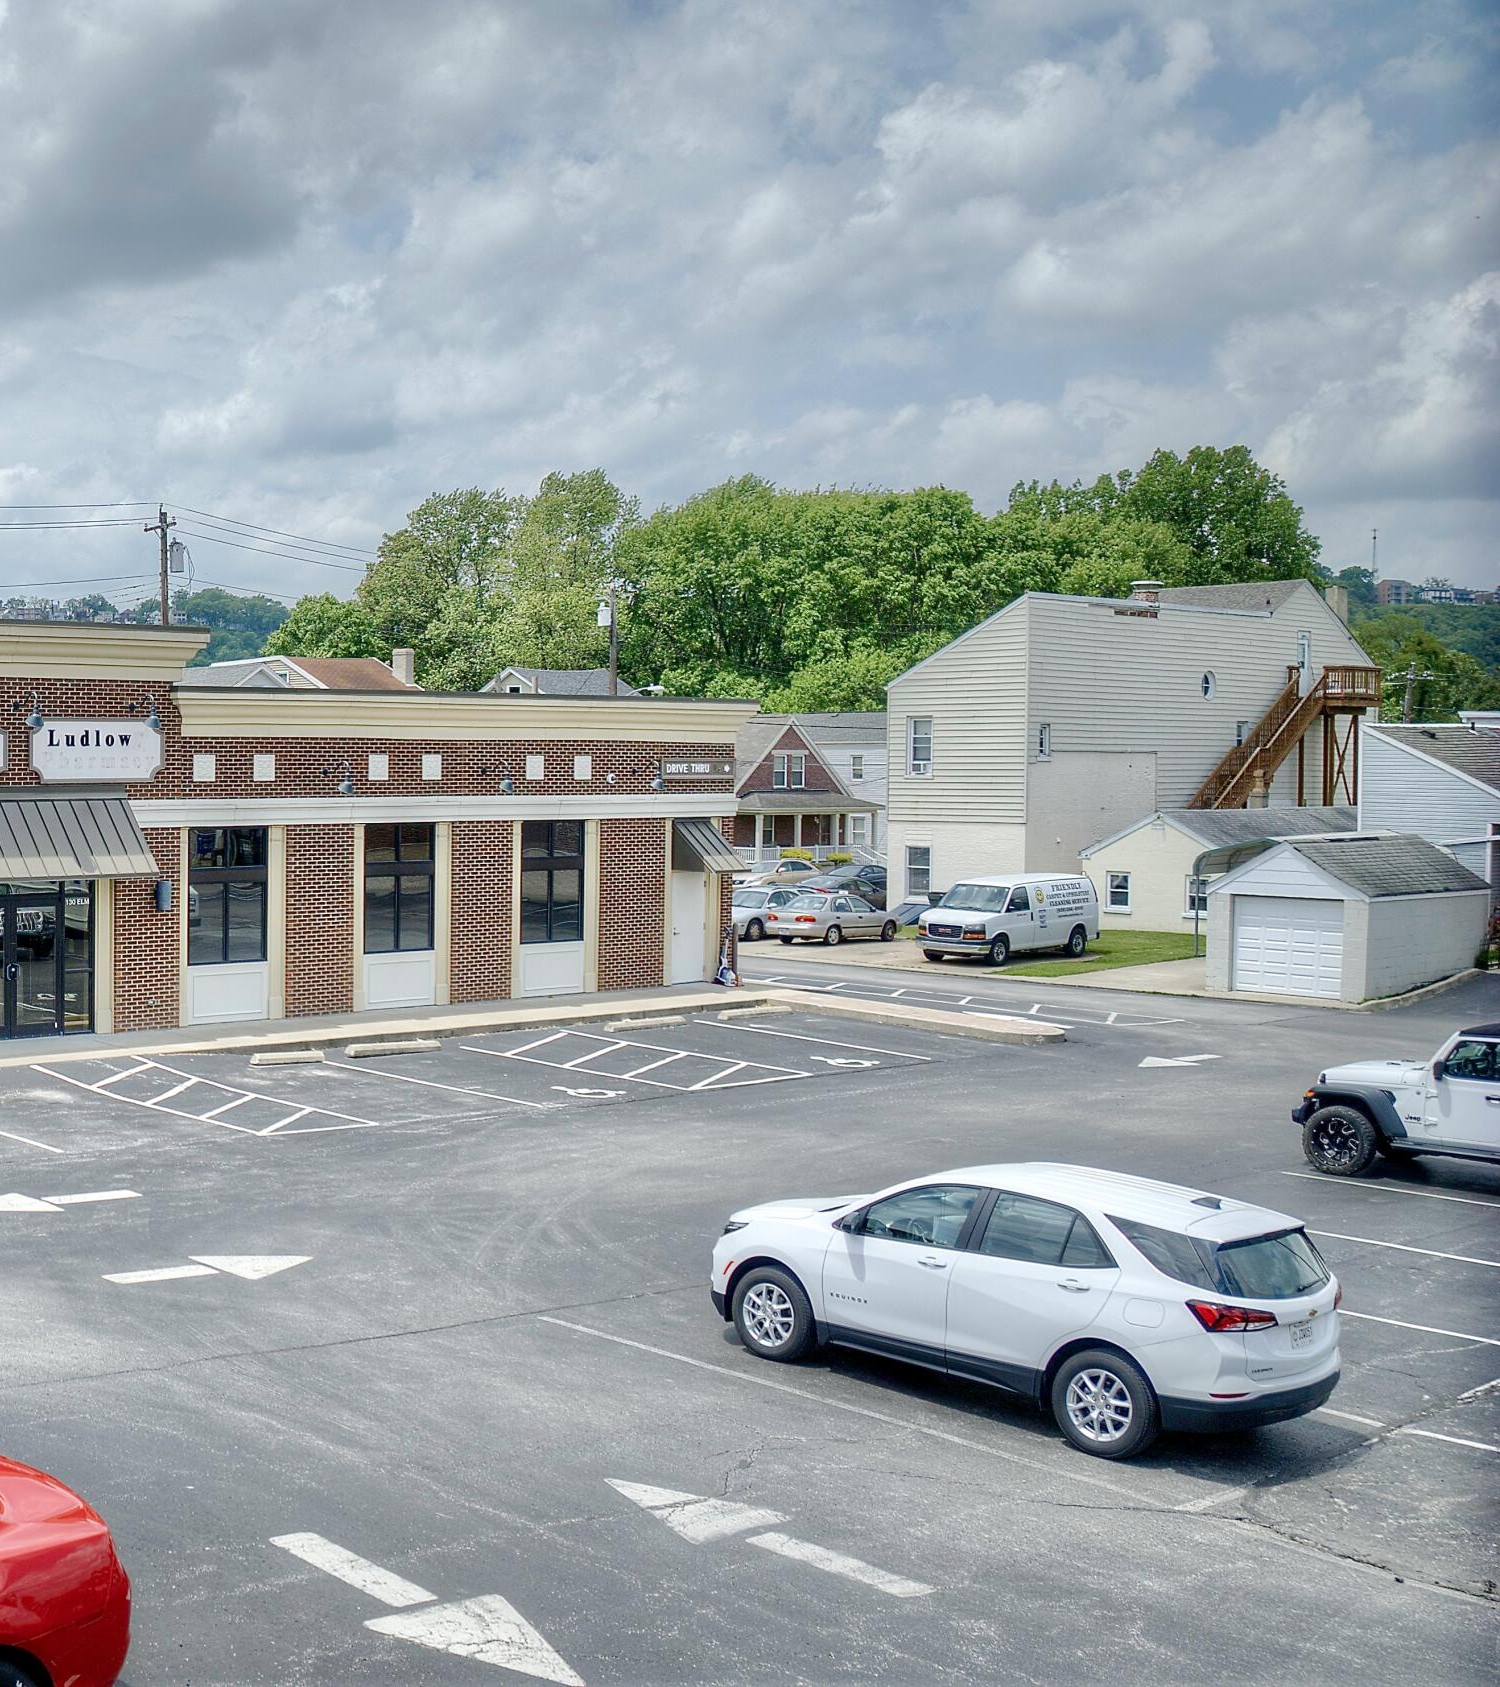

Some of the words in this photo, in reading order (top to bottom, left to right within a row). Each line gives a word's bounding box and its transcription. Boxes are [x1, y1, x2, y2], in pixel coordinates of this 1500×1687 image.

[47, 729, 132, 747] Ludlow
[666, 763, 689, 774] DRIVE
[690, 763, 710, 774] THRU
[1050, 882, 1082, 893] FRIENDLY
